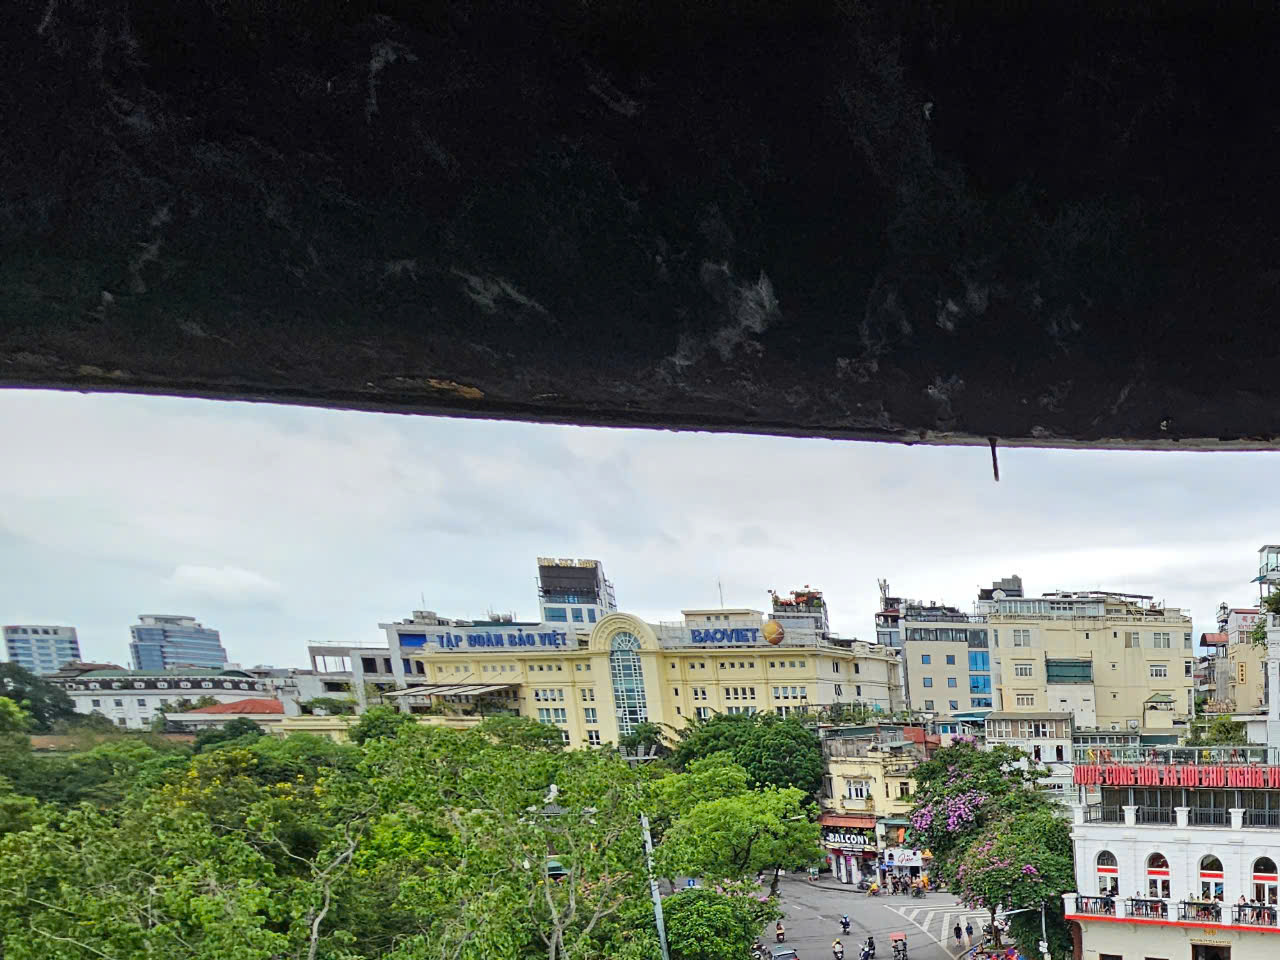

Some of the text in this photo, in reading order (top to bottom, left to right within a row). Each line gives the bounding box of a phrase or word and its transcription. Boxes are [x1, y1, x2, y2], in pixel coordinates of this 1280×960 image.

[436, 628, 567, 650] TẬP ĐOÀN BẢO VIỆT
[691, 628, 759, 643] BAOVIET
[1228, 762, 1264, 788] NGHĨA
[828, 832, 869, 845] BALCONY
